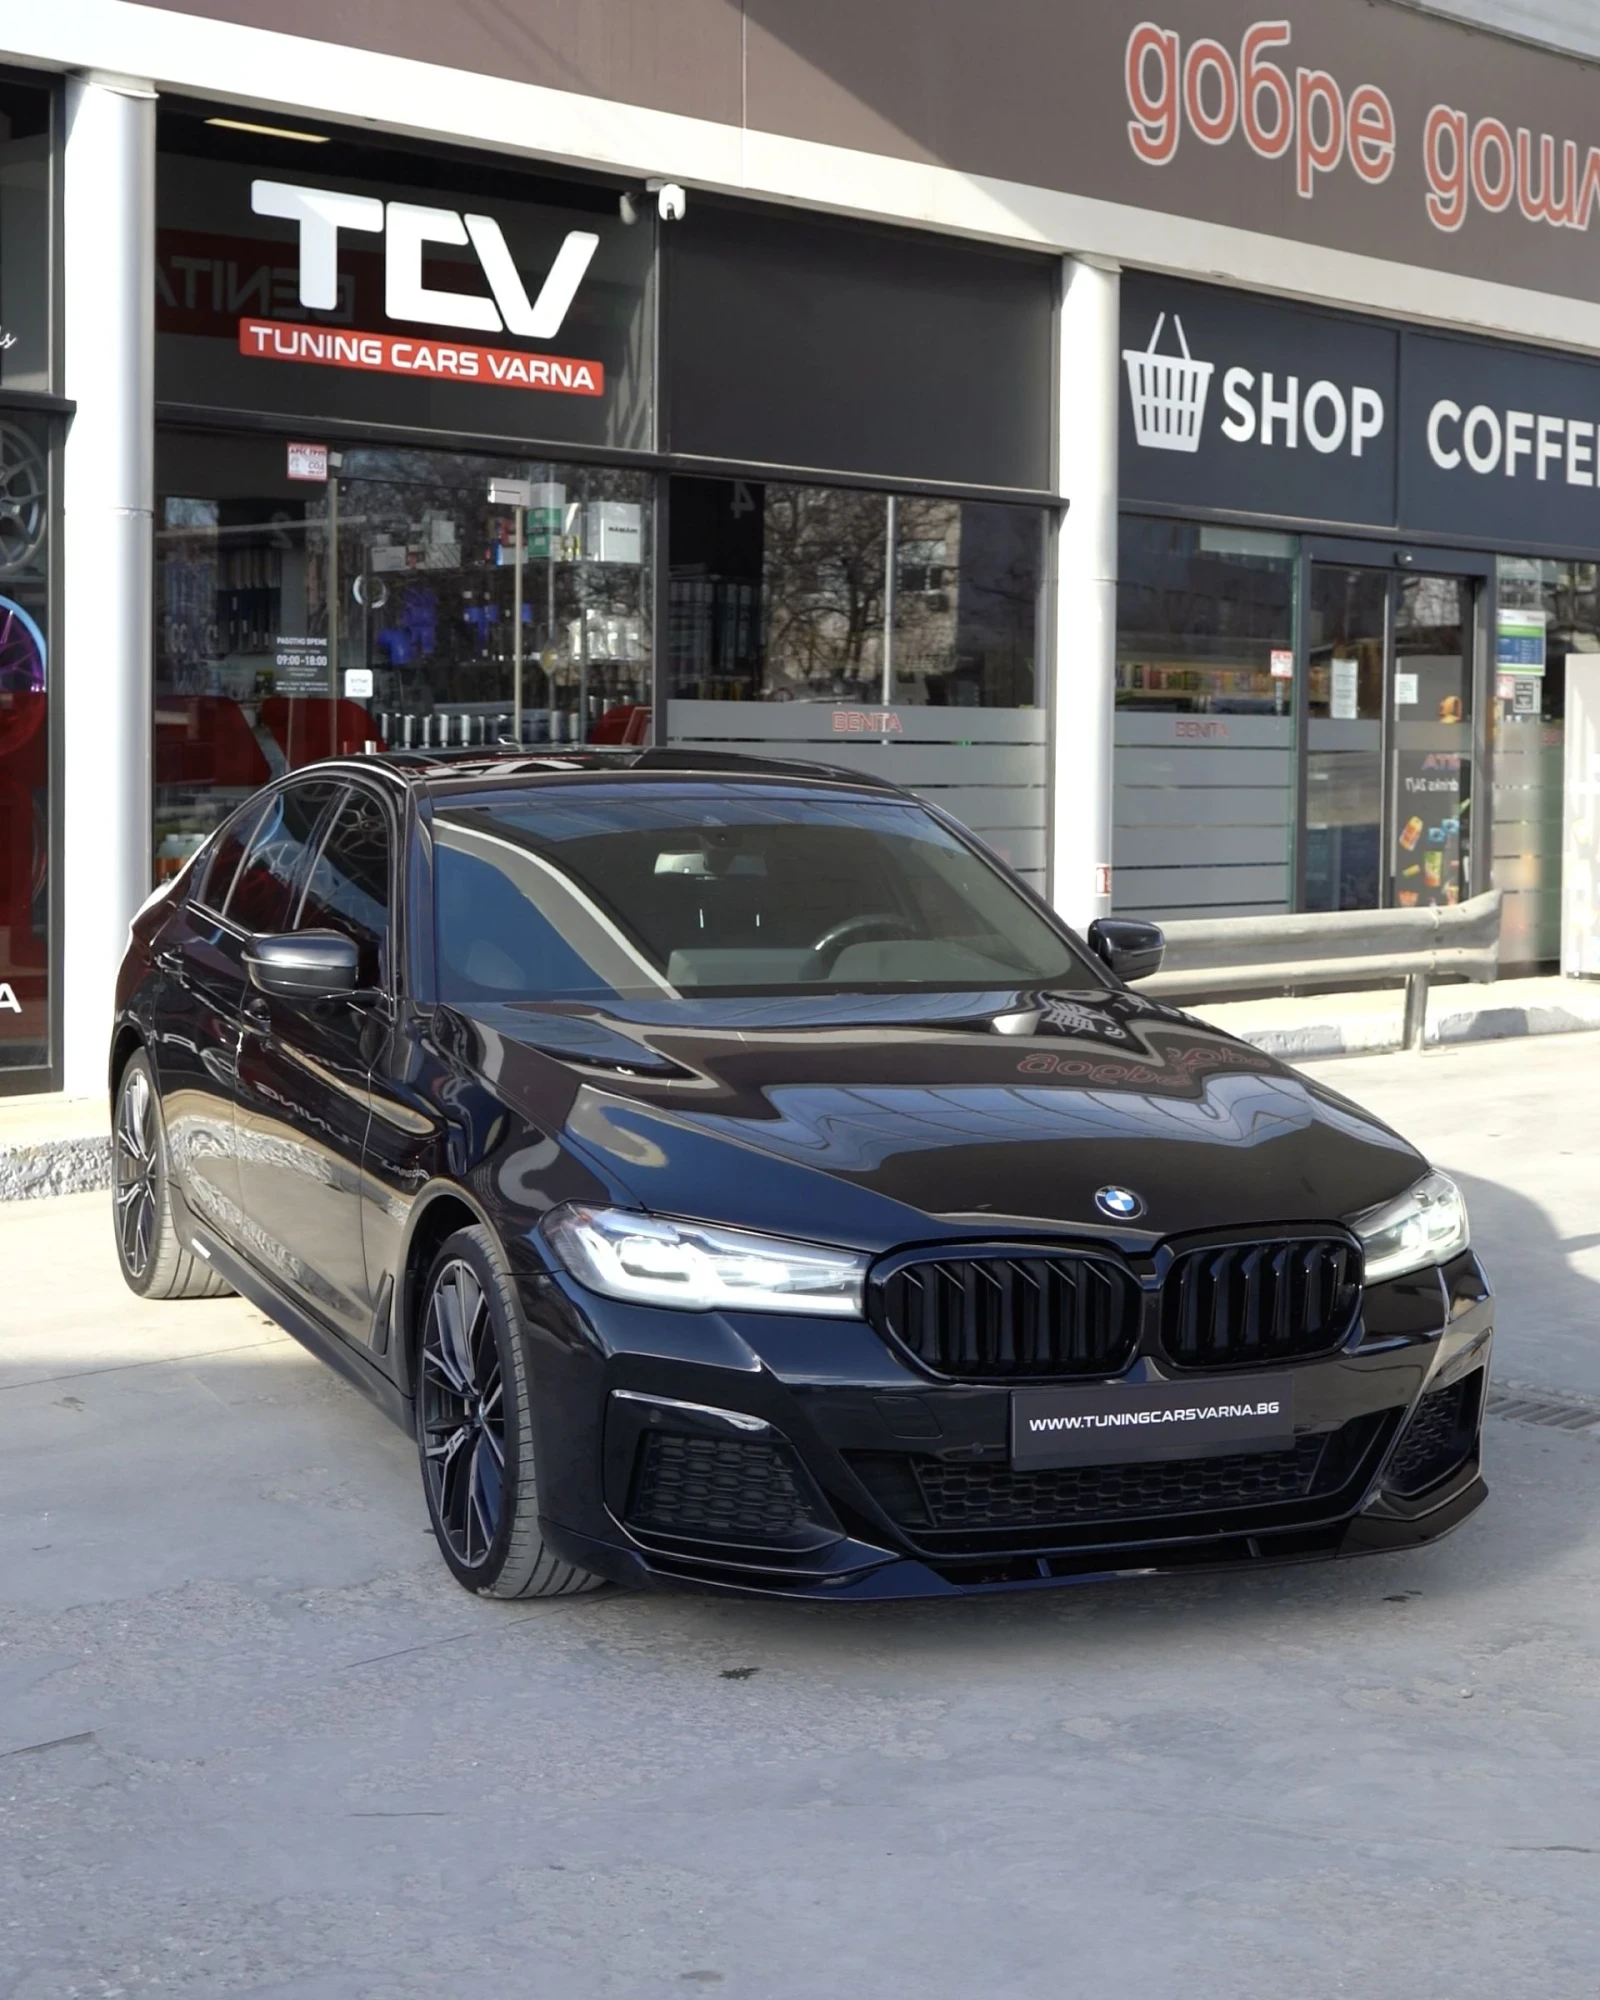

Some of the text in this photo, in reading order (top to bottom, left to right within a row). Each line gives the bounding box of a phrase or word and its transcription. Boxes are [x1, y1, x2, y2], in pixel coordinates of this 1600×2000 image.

[1125, 20, 1395, 198] добре
[251, 179, 600, 339] TCV
[250, 326, 595, 390] TUNING CARS VARNA
[1221, 365, 1384, 457] SHOP
[1427, 399, 1600, 488] COFFE
[832, 711, 903, 733] BENITA
[1029, 1402, 1280, 1432] WWW.TUNINGCARSVARNA.BG
